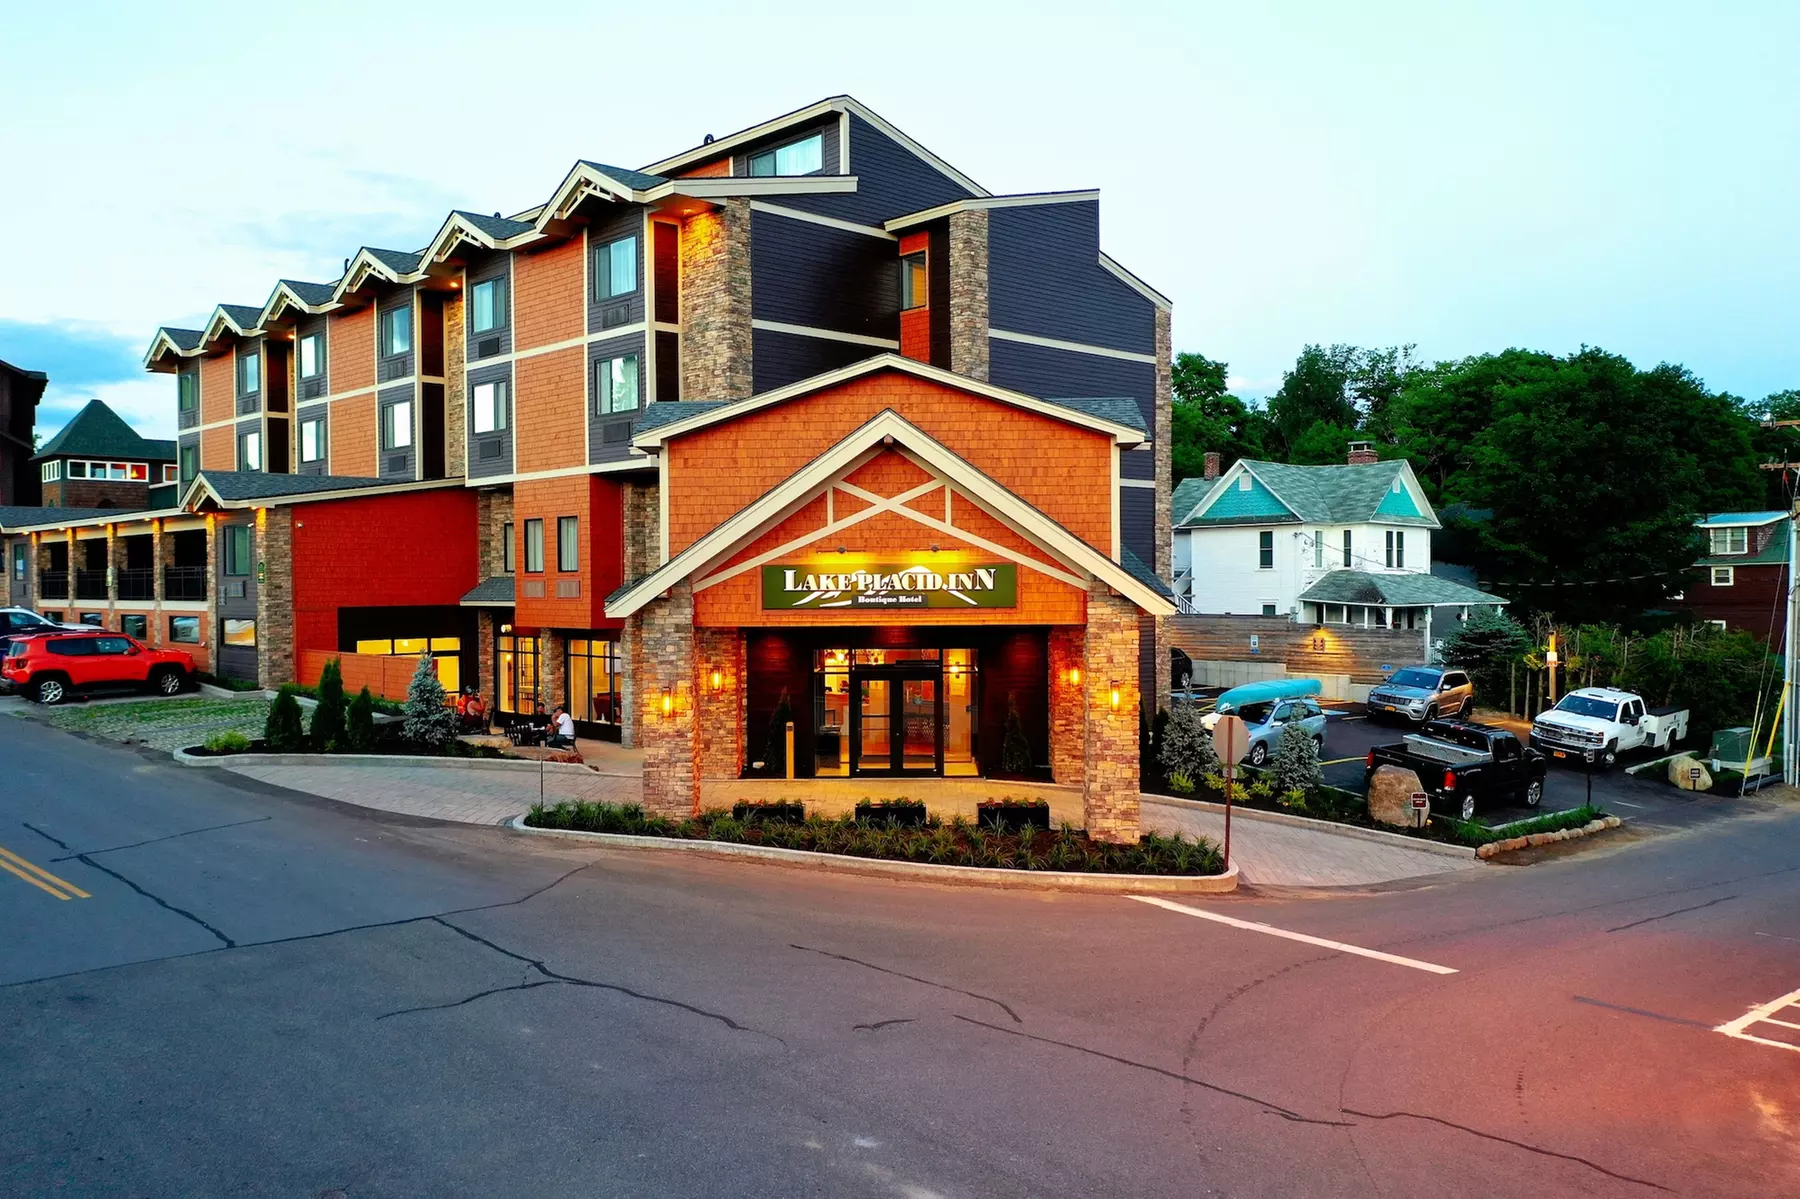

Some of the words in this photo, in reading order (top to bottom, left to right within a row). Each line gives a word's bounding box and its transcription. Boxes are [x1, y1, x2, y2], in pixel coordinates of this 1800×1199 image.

[783, 569, 852, 591] LAKE
[856, 573, 943, 591] PLACID
[947, 568, 996, 591] INN
[858, 595, 897, 605] Boutique
[898, 595, 922, 603] Hotel
